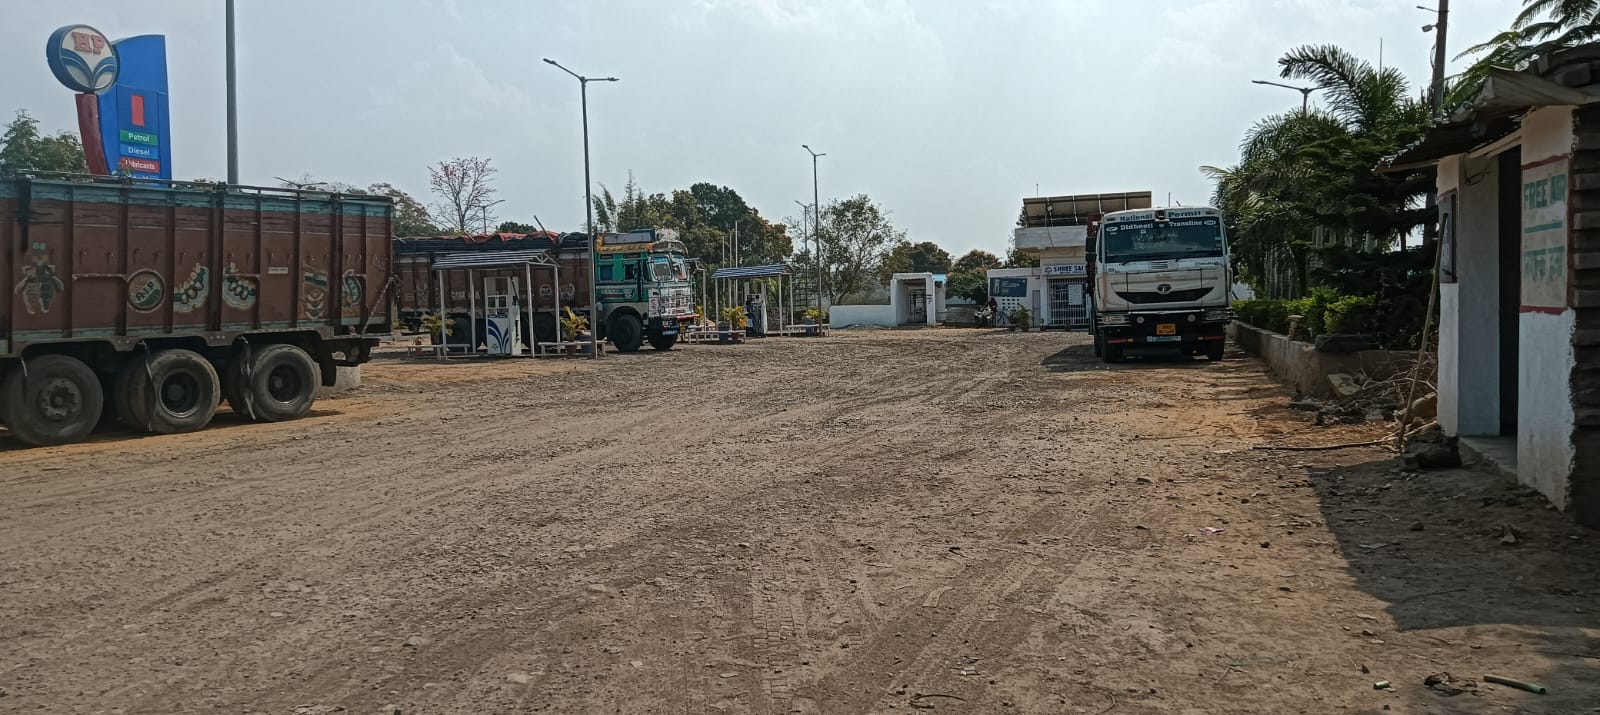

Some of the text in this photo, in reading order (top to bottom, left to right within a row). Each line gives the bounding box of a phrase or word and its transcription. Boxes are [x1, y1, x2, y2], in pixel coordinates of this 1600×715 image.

[72, 32, 105, 55] HP
[128, 132, 150, 142] Petrol
[128, 146, 150, 155] Diesel
[1524, 174, 1566, 208] FREE AIR
[1120, 210, 1201, 221] National Permit
